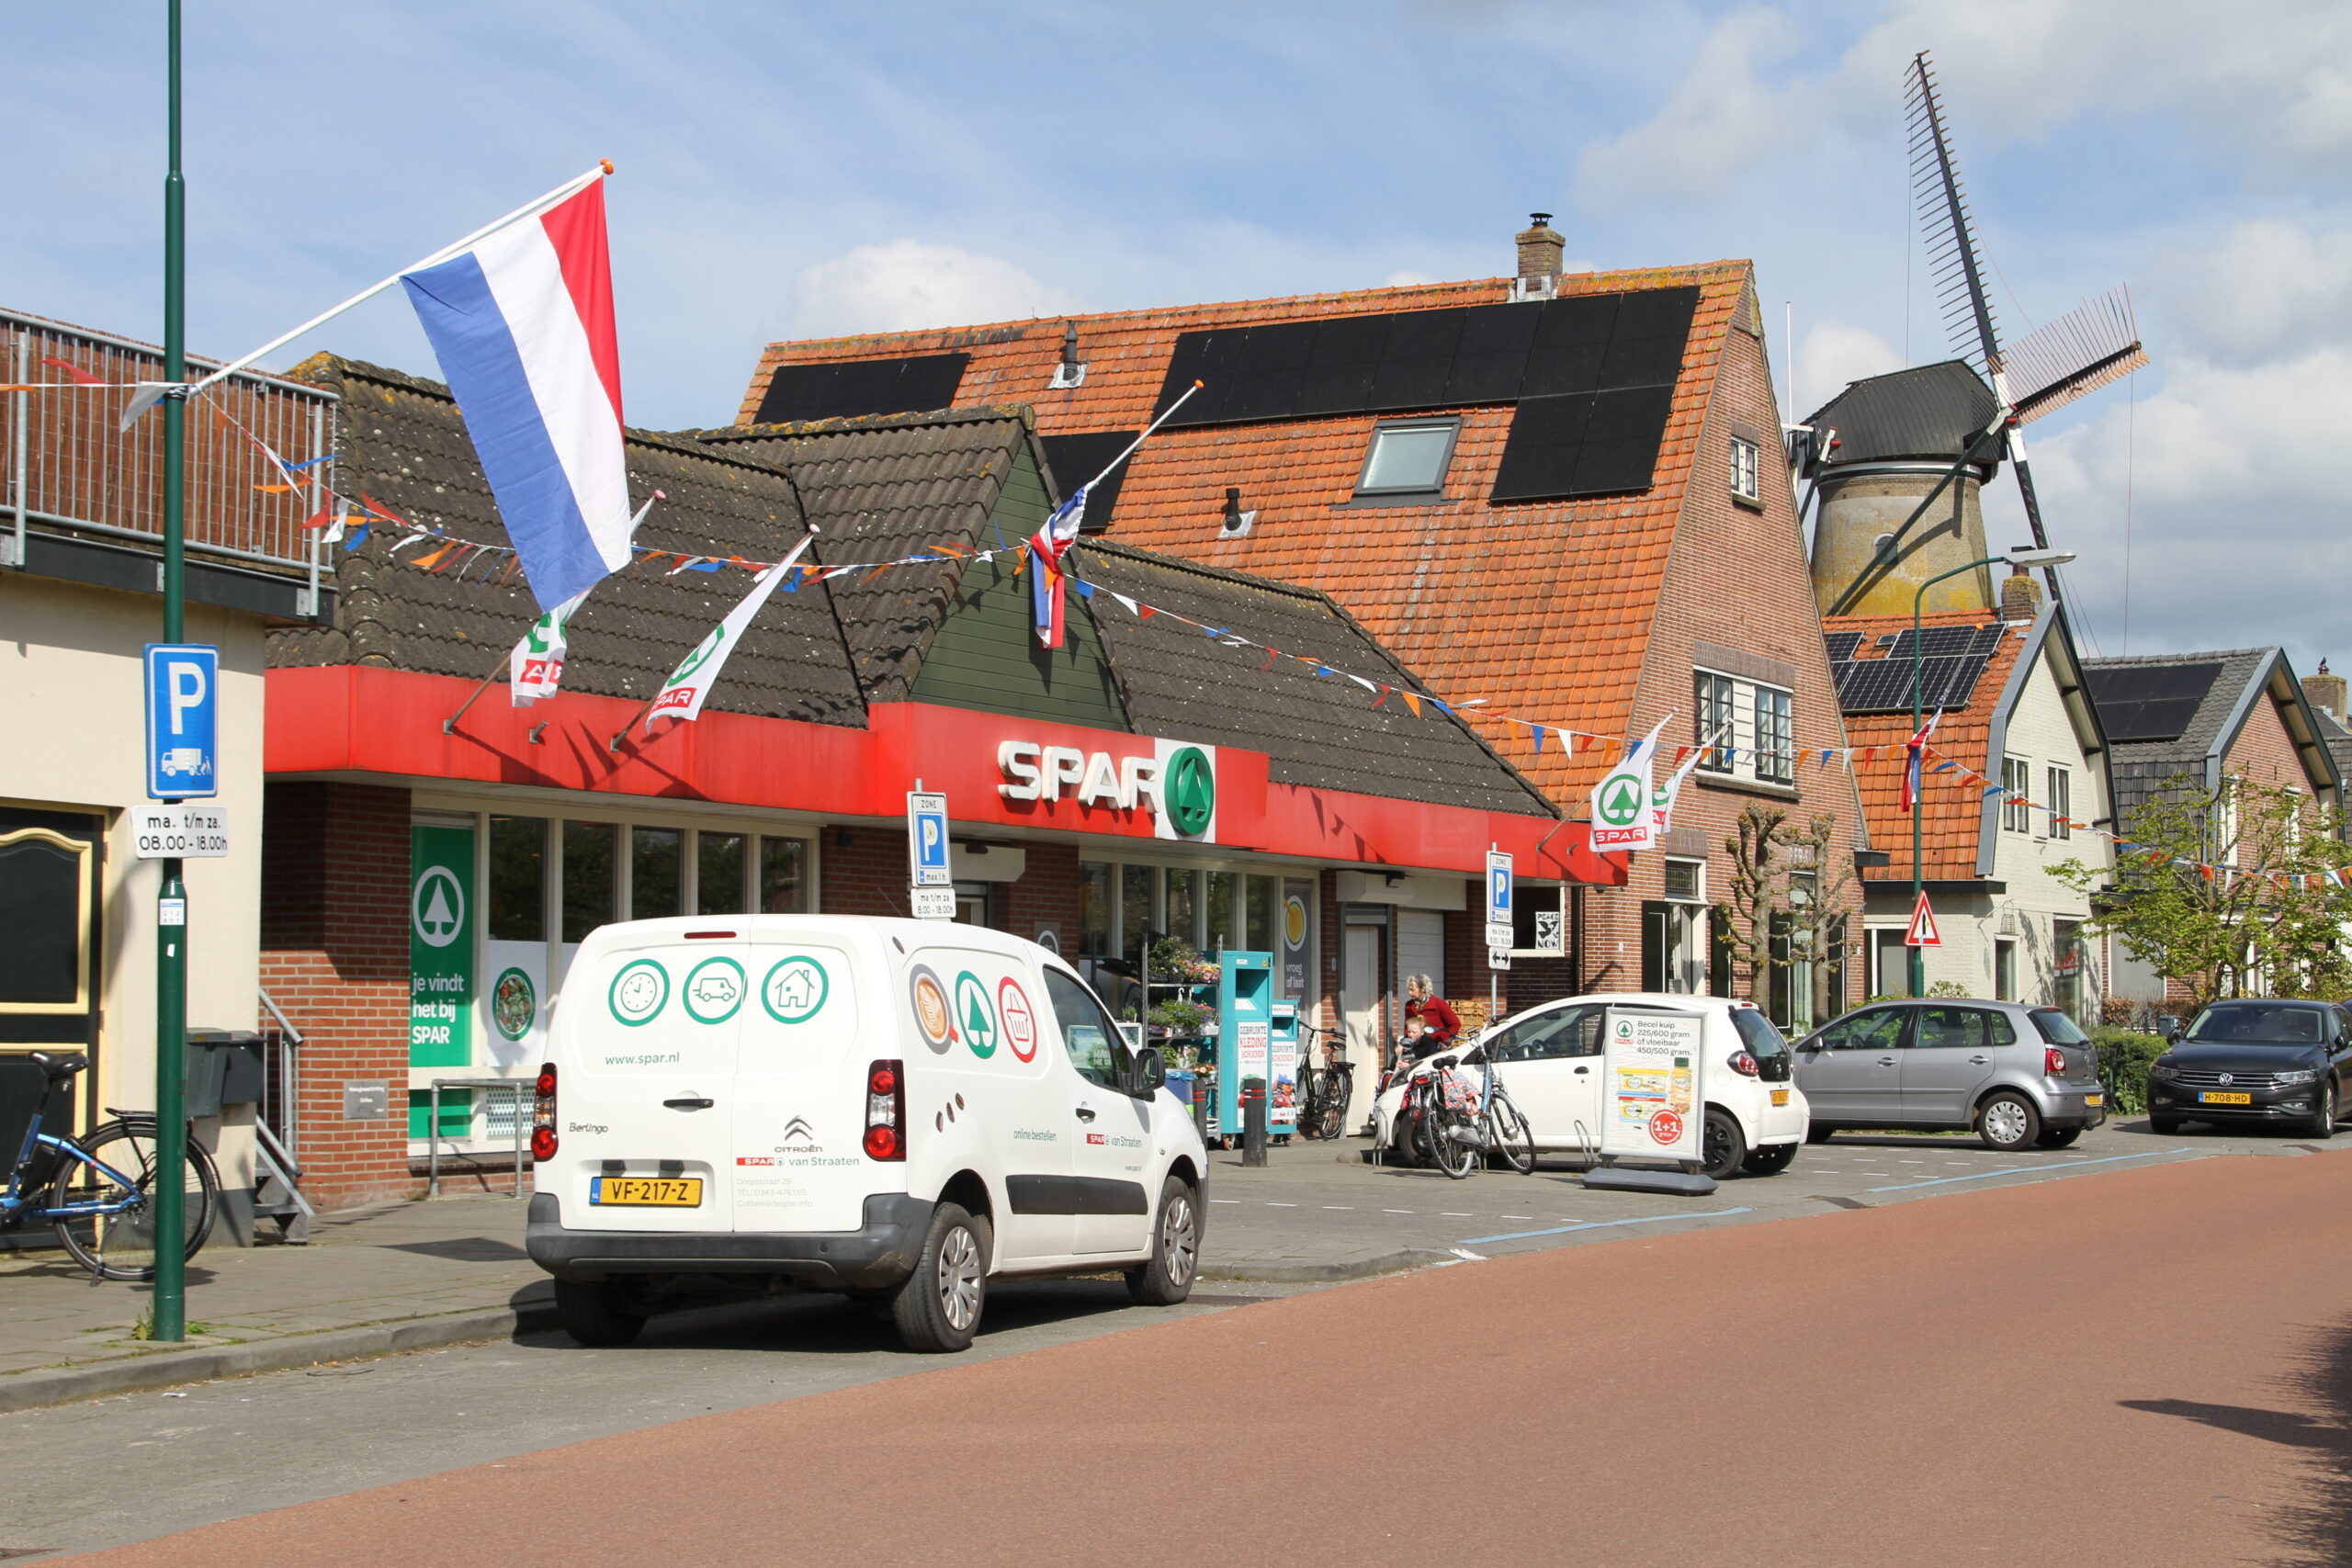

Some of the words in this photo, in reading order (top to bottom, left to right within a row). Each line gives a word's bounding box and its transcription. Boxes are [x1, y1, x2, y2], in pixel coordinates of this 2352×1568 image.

[168, 661, 206, 735] P
[998, 740, 1161, 813] SPAR
[921, 799, 937, 808] ZONE
[148, 817, 176, 829] ma.
[184, 812, 204, 829] t/m
[208, 818, 220, 829] za.
[922, 819, 938, 861] P
[1595, 829, 1645, 842] SPAR
[139, 836, 186, 851] 08.00
[197, 835, 228, 851] 18.00h
[1496, 872, 1507, 905] P
[930, 892, 942, 902] t/m
[1538, 940, 1559, 948] NOW
[411, 972, 425, 996] je
[428, 973, 464, 992] vindt
[413, 998, 437, 1018] het
[438, 998, 456, 1023] bij
[1659, 1021, 1675, 1030] kuip
[412, 1025, 450, 1044] SPAR
[1637, 1029, 1669, 1037] 225/600
[1239, 1037, 1267, 1048] KLEDING
[1646, 1038, 1680, 1046] vloeibaar
[1637, 1046, 1669, 1055] 450/500
[605, 1051, 680, 1066] www.spar.nl
[2205, 1093, 2247, 1102] H-708-HD
[569, 1122, 608, 1134] Berlingo
[1654, 1120, 1679, 1132] 1+1
[1013, 1128, 1031, 1140] online
[1031, 1129, 1057, 1142] bestellen
[1091, 1135, 1105, 1144] SPAR
[1111, 1137, 1120, 1146] van
[1121, 1136, 1141, 1147] Straaten
[775, 1145, 823, 1153] CITROËN
[810, 1157, 860, 1166] Straaten
[612, 1182, 688, 1201] VF-217-Z
